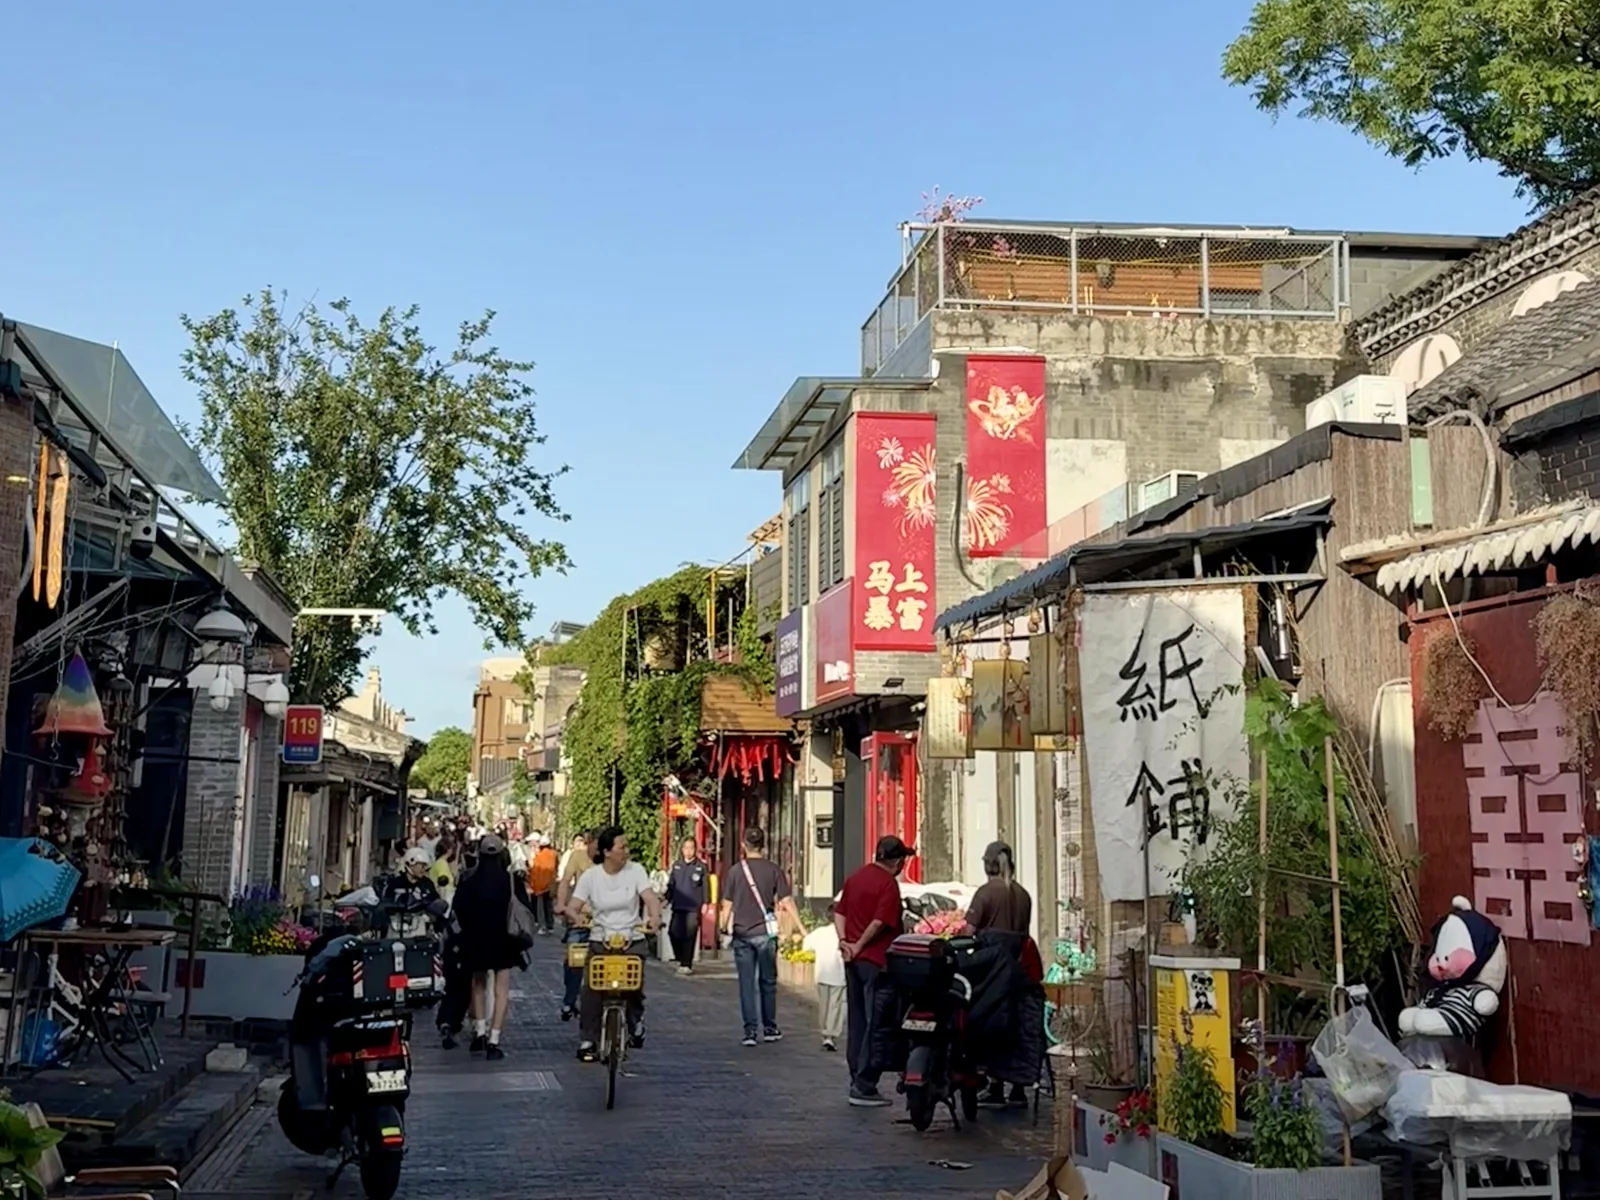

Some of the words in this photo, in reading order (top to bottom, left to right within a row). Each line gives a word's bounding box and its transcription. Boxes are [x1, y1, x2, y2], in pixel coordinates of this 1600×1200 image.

[864, 560, 928, 595] 马上
[863, 595, 928, 631] 暴富
[290, 716, 318, 735] 119
